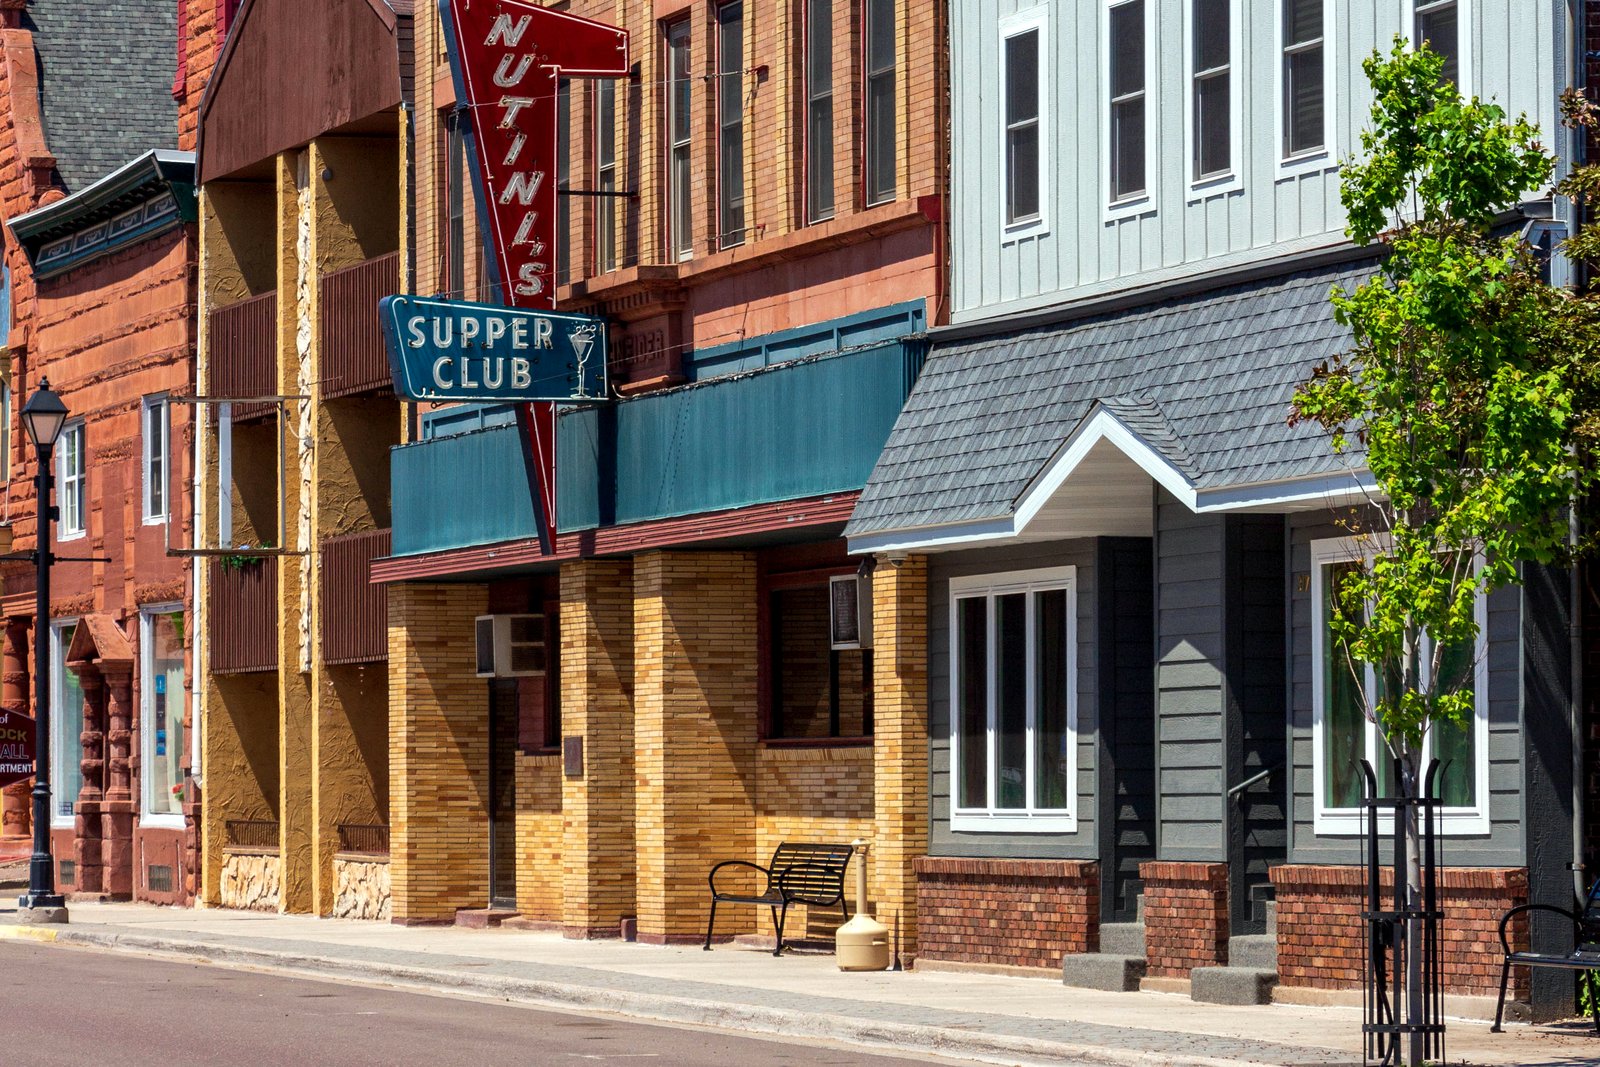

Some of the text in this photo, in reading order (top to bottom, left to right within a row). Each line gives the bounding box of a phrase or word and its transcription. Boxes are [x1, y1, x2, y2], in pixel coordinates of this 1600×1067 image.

[483, 12, 546, 297] NUTINI'S
[407, 315, 554, 350] SUPPER
[432, 356, 532, 390] CLUB
[0, 713, 8, 724] of
